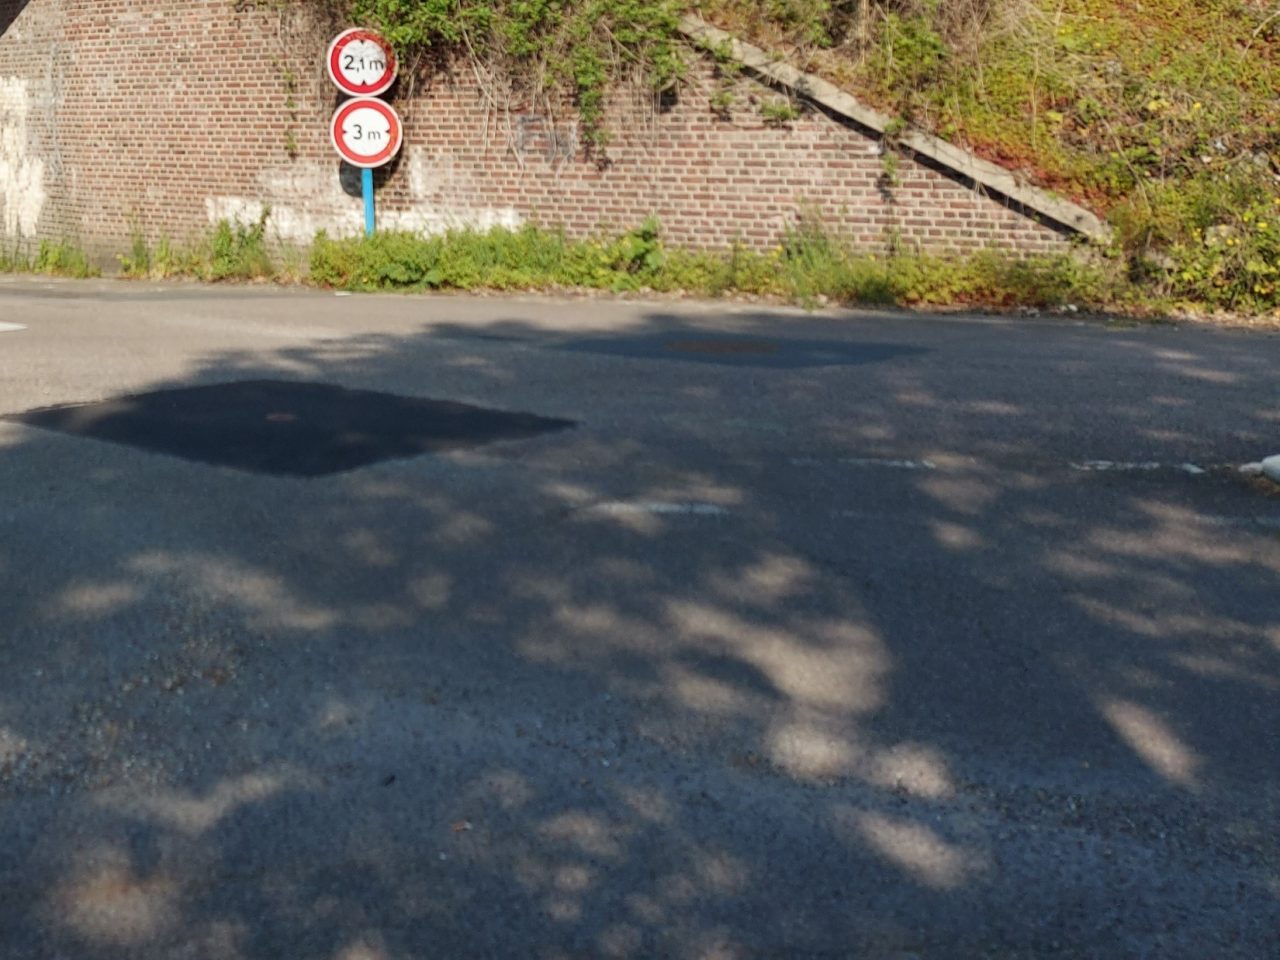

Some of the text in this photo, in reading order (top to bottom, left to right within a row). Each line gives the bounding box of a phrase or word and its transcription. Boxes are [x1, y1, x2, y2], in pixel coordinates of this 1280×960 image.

[344, 55, 384, 73] 2,1 m
[352, 124, 381, 140] 3 m
